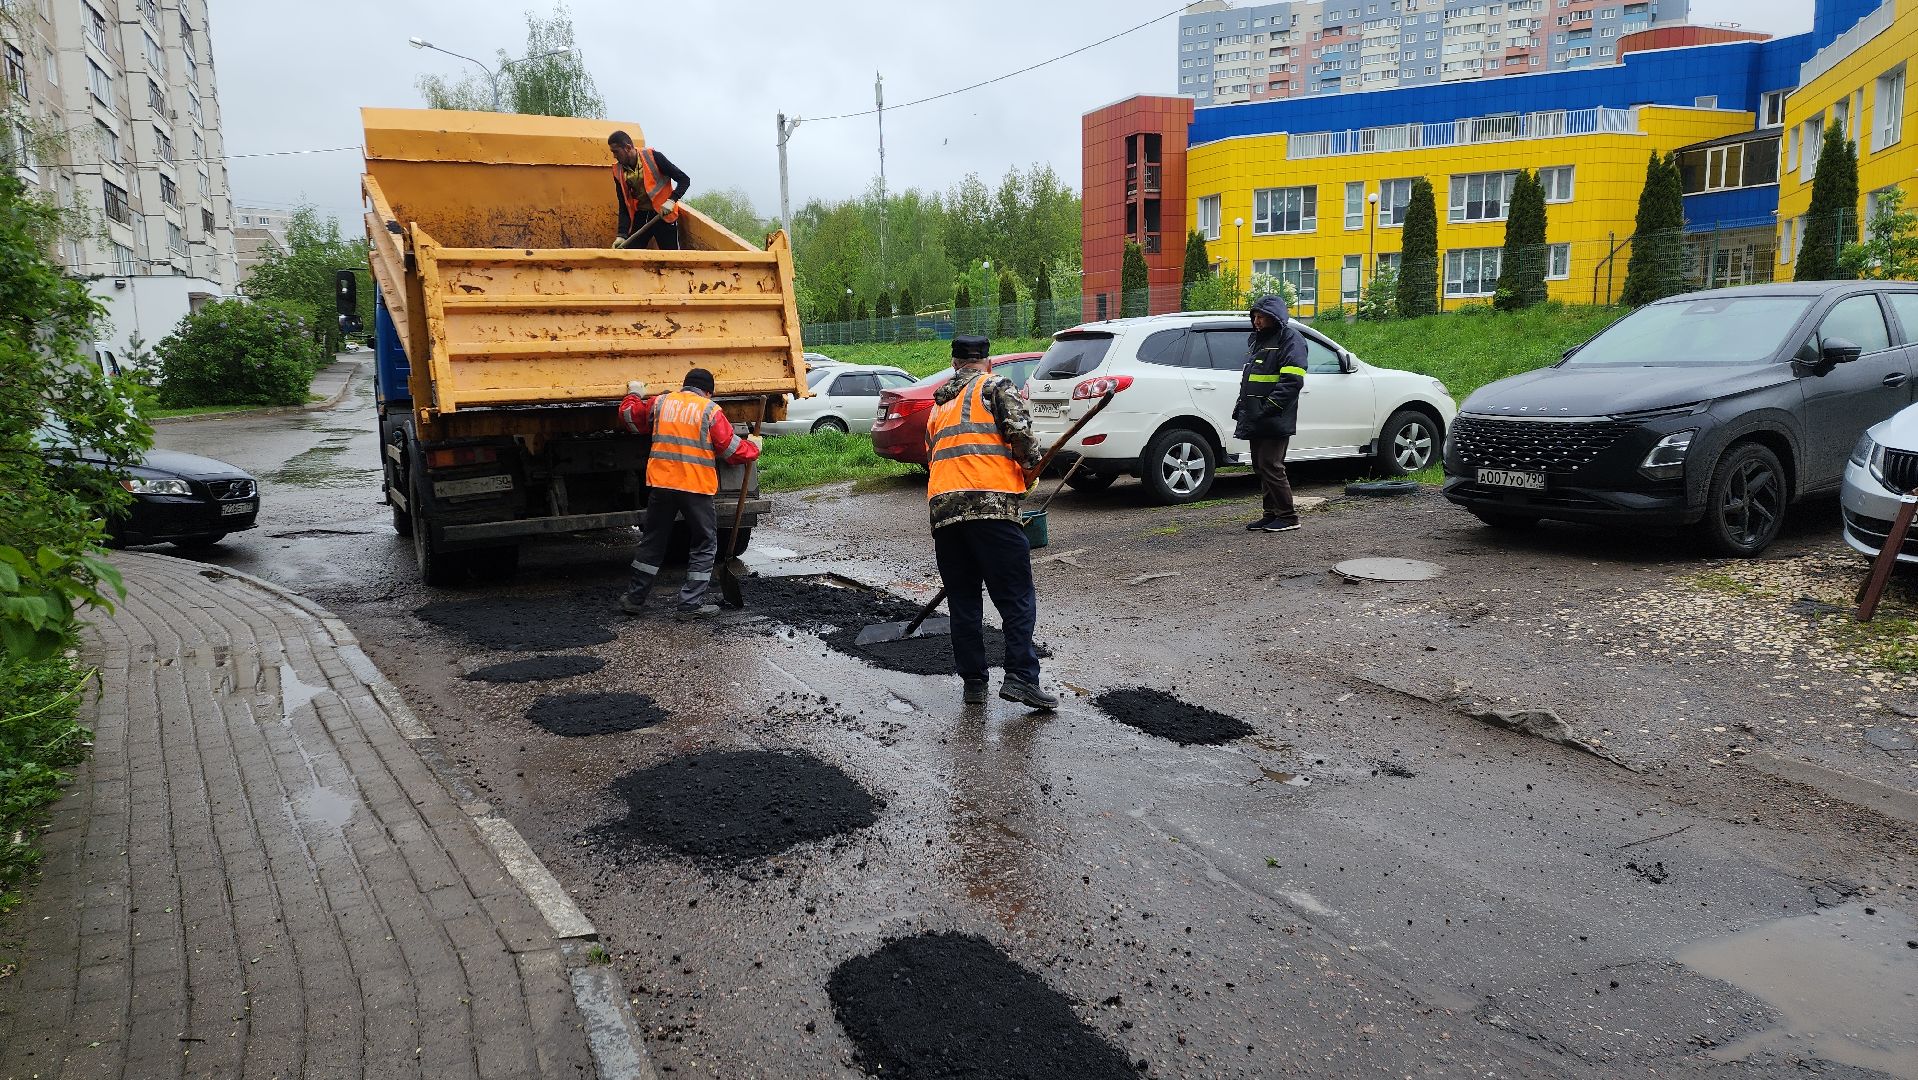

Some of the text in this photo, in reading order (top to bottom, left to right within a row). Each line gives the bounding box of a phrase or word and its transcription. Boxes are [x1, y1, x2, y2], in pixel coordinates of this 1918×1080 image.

[662, 399, 683, 423] МБУ
[1480, 471, 1523, 486] А007УО
[1525, 472, 1544, 484] 790
